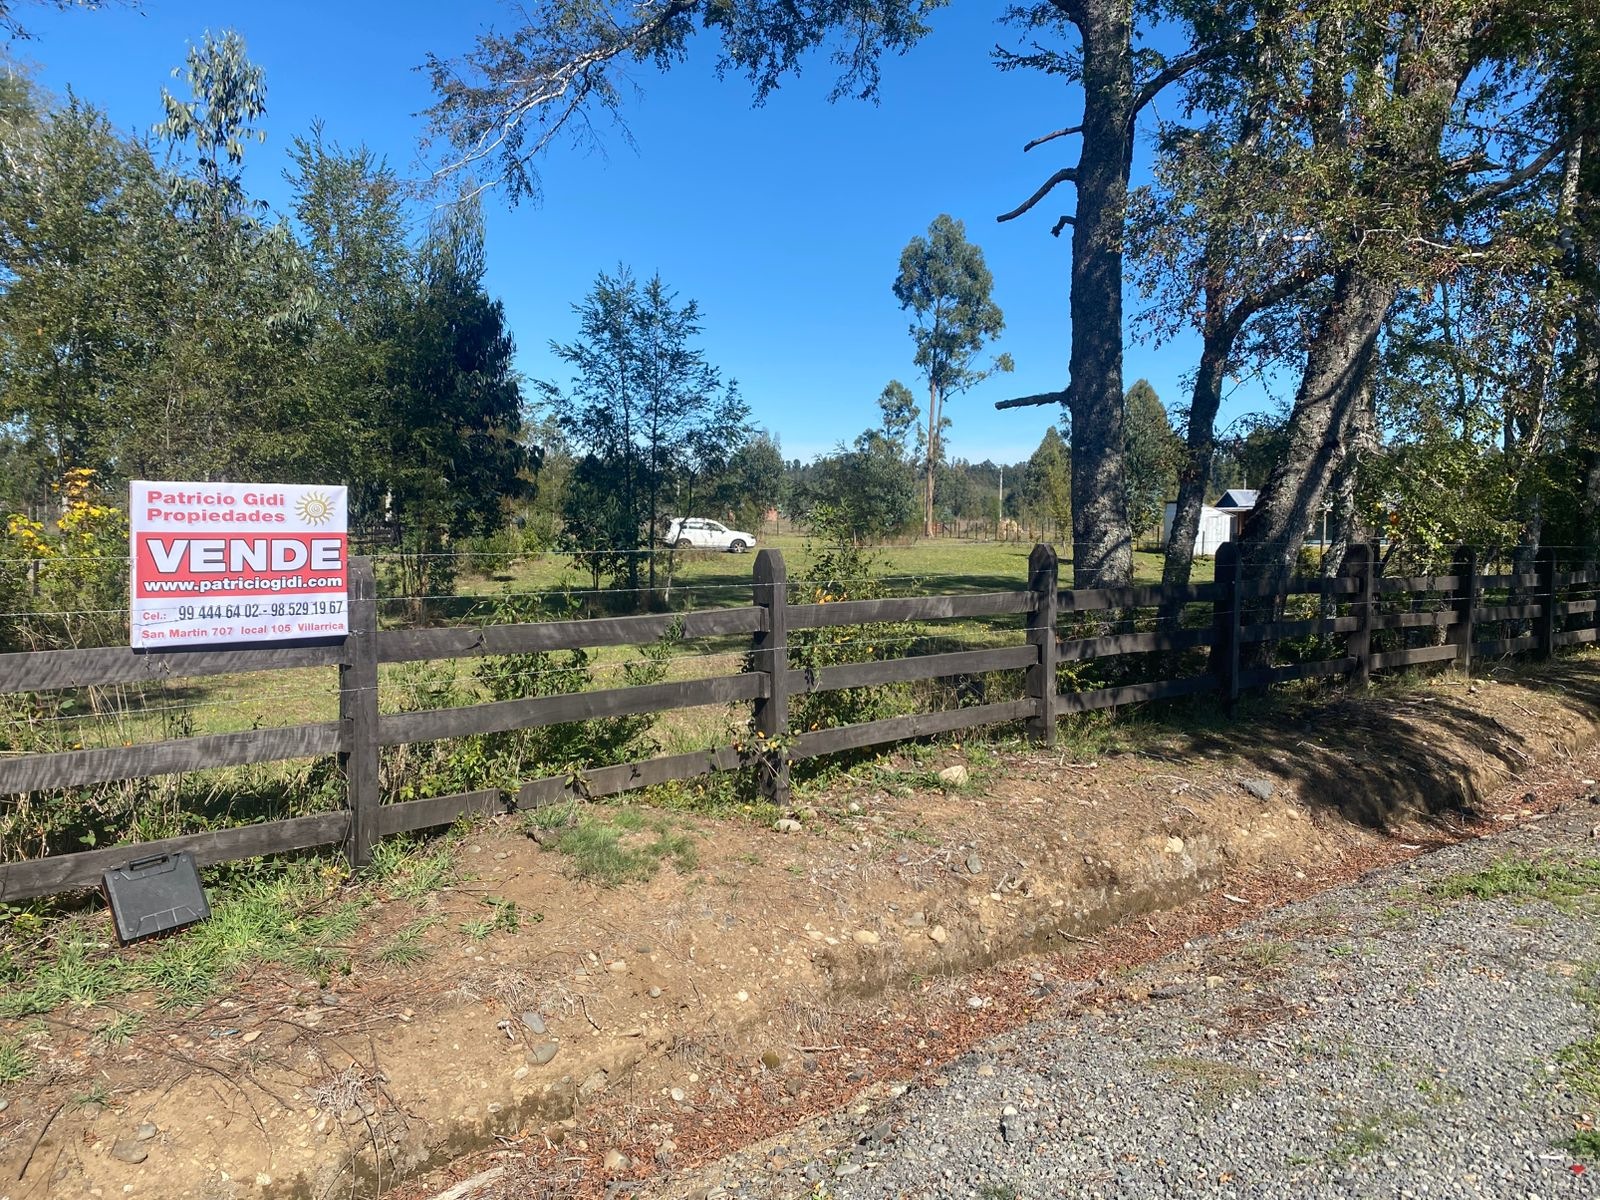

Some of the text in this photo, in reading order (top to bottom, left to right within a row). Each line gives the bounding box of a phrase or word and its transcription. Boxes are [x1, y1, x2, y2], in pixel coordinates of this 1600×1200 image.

[147, 491, 285, 506] Patricio Gidi
[147, 508, 285, 523] Propiedades
[146, 538, 342, 573] VENDE
[143, 576, 342, 592] www.patriciogidi.com
[143, 612, 166, 620] Cel.:
[178, 605, 194, 620] 99
[198, 605, 221, 619] 444
[225, 604, 240, 618] 64
[244, 603, 259, 618] 02
[271, 602, 285, 616] 98
[288, 601, 309, 616] 529
[312, 601, 326, 615] 19
[329, 600, 343, 614] 67
[142, 622, 344, 639] San Martin 707 local 105 Villarrica
